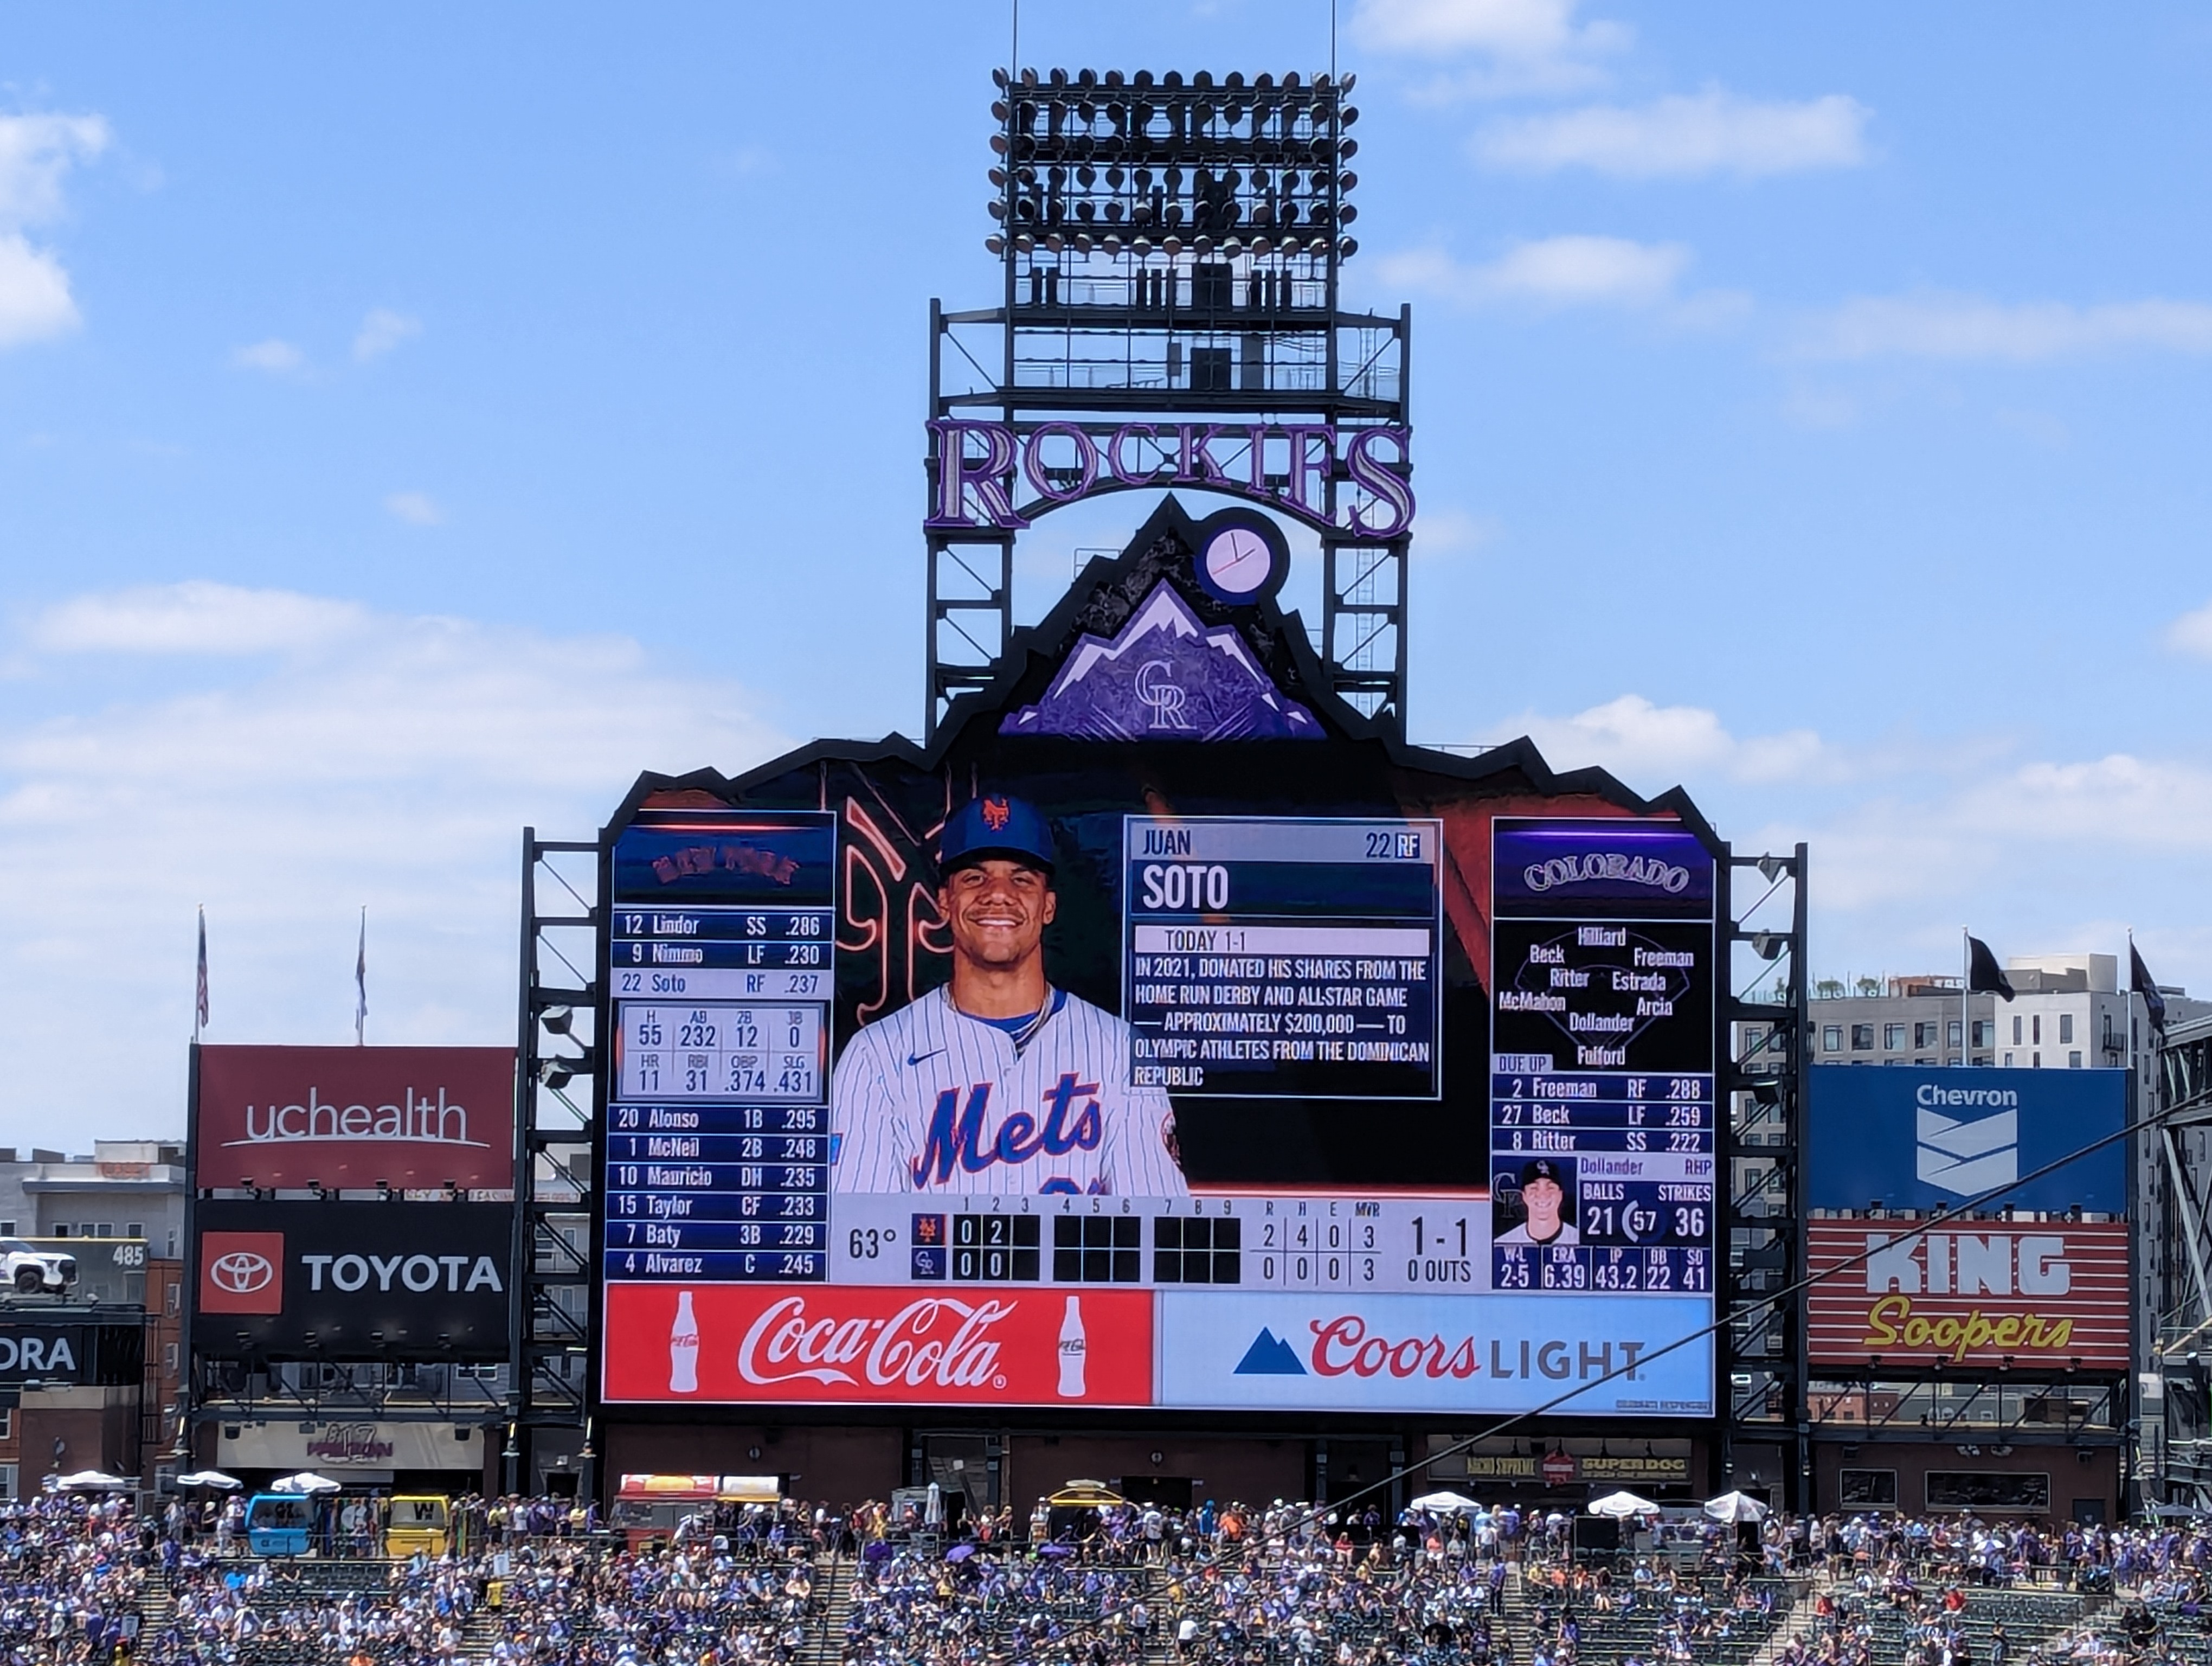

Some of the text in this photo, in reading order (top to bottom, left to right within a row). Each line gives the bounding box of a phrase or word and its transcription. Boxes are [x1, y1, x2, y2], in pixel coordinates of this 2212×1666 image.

[924, 420, 1416, 538] ROCKIES
[1143, 830, 1418, 858] JUAN 22 RF
[1524, 854, 1689, 893] COLORADO
[1143, 864, 1229, 909] SOTO
[625, 915, 642, 934] 12
[652, 915, 699, 934] Lindor
[747, 917, 766, 935] SS
[1165, 930, 1245, 951] TODAY 1-1
[1578, 927, 1626, 946] Hilliard
[632, 944, 819, 965] 9 Nimmo LF .230
[1530, 945, 1565, 963] Beck
[1635, 947, 1694, 966] Freeman
[1136, 958, 1426, 980] IN 2021, DONATED HIS SHARES FROM THE
[1551, 969, 1590, 987] Ritter
[622, 973, 818, 994] 22 Soto RF .237
[1612, 972, 1666, 991] Estrada
[1135, 985, 1407, 1007] HOME RUN DERBY AND ALL-STAR GAME
[1499, 991, 1565, 1011] McMahon
[1636, 997, 1673, 1016] Arcia
[1165, 1012, 1405, 1036] APPROXIMATELY $200,000 TO
[1570, 1013, 1635, 1031] Dollander
[639, 1026, 800, 1048] 55 232 12 0
[1135, 1039, 1429, 1061] OLYMPIC ATHLETES FROM THE DOMINICAN
[641, 1054, 805, 1069] HR OBP SLG
[1500, 1056, 1546, 1072] DUE UP
[639, 1069, 812, 1092] 11 31 .374 .431
[1134, 1066, 1204, 1086] REPUBLIC
[1513, 1078, 1648, 1098] 2 Freeman RF
[1916, 1084, 2018, 1107] Chevron
[246, 1087, 466, 1139] uchealth
[619, 1108, 816, 1129] 20 Alonso 1B .295
[1502, 1105, 1700, 1126] 27 Beck LF .259
[911, 1072, 1102, 1190] Mets
[1513, 1131, 1700, 1152] 8 Ritter SS .222
[648, 1138, 699, 1157] McNeil
[742, 1139, 762, 1158] 2B
[619, 1167, 815, 1187] 10 Mauricio DH .235
[1580, 1158, 1644, 1175] Dollander
[1583, 1184, 1711, 1201] BALLS STRIKES
[619, 1195, 814, 1219] 15 Taylor CF .233
[993, 1198, 1000, 1212] 2
[1021, 1198, 1028, 1212] 3
[1063, 1199, 1070, 1213] 4
[1092, 1199, 1100, 1213] 5
[1165, 1199, 1172, 1214] 7
[1194, 1200, 1202, 1214] 8
[1224, 1200, 1231, 1215] 9
[1266, 1202, 1274, 1216] R
[1330, 1202, 1337, 1217] E
[1587, 1207, 1704, 1236] 21 57 36
[627, 1224, 814, 1248] 7 Baty 3B .229
[850, 1229, 896, 1258] 63°
[961, 1220, 1374, 1248] 0 2 2 4 0 3
[113, 1245, 144, 1266] 485
[626, 1254, 813, 1274] 4 Alvarez C .245
[1553, 1247, 1576, 1263] ERA
[1867, 1234, 2070, 1296] KING
[301, 1254, 503, 1291] TOYOTA
[961, 1253, 1374, 1281] 0 0 0 0 0 3
[1408, 1260, 1471, 1282] 0 OUTS
[1501, 1264, 1705, 1290] 2-5 6.39 43.2 22 41
[1862, 1295, 2073, 1363] Soopers
[737, 1295, 1018, 1387] Coca-Cola
[1309, 1315, 1646, 1381] Coors LIGHT
